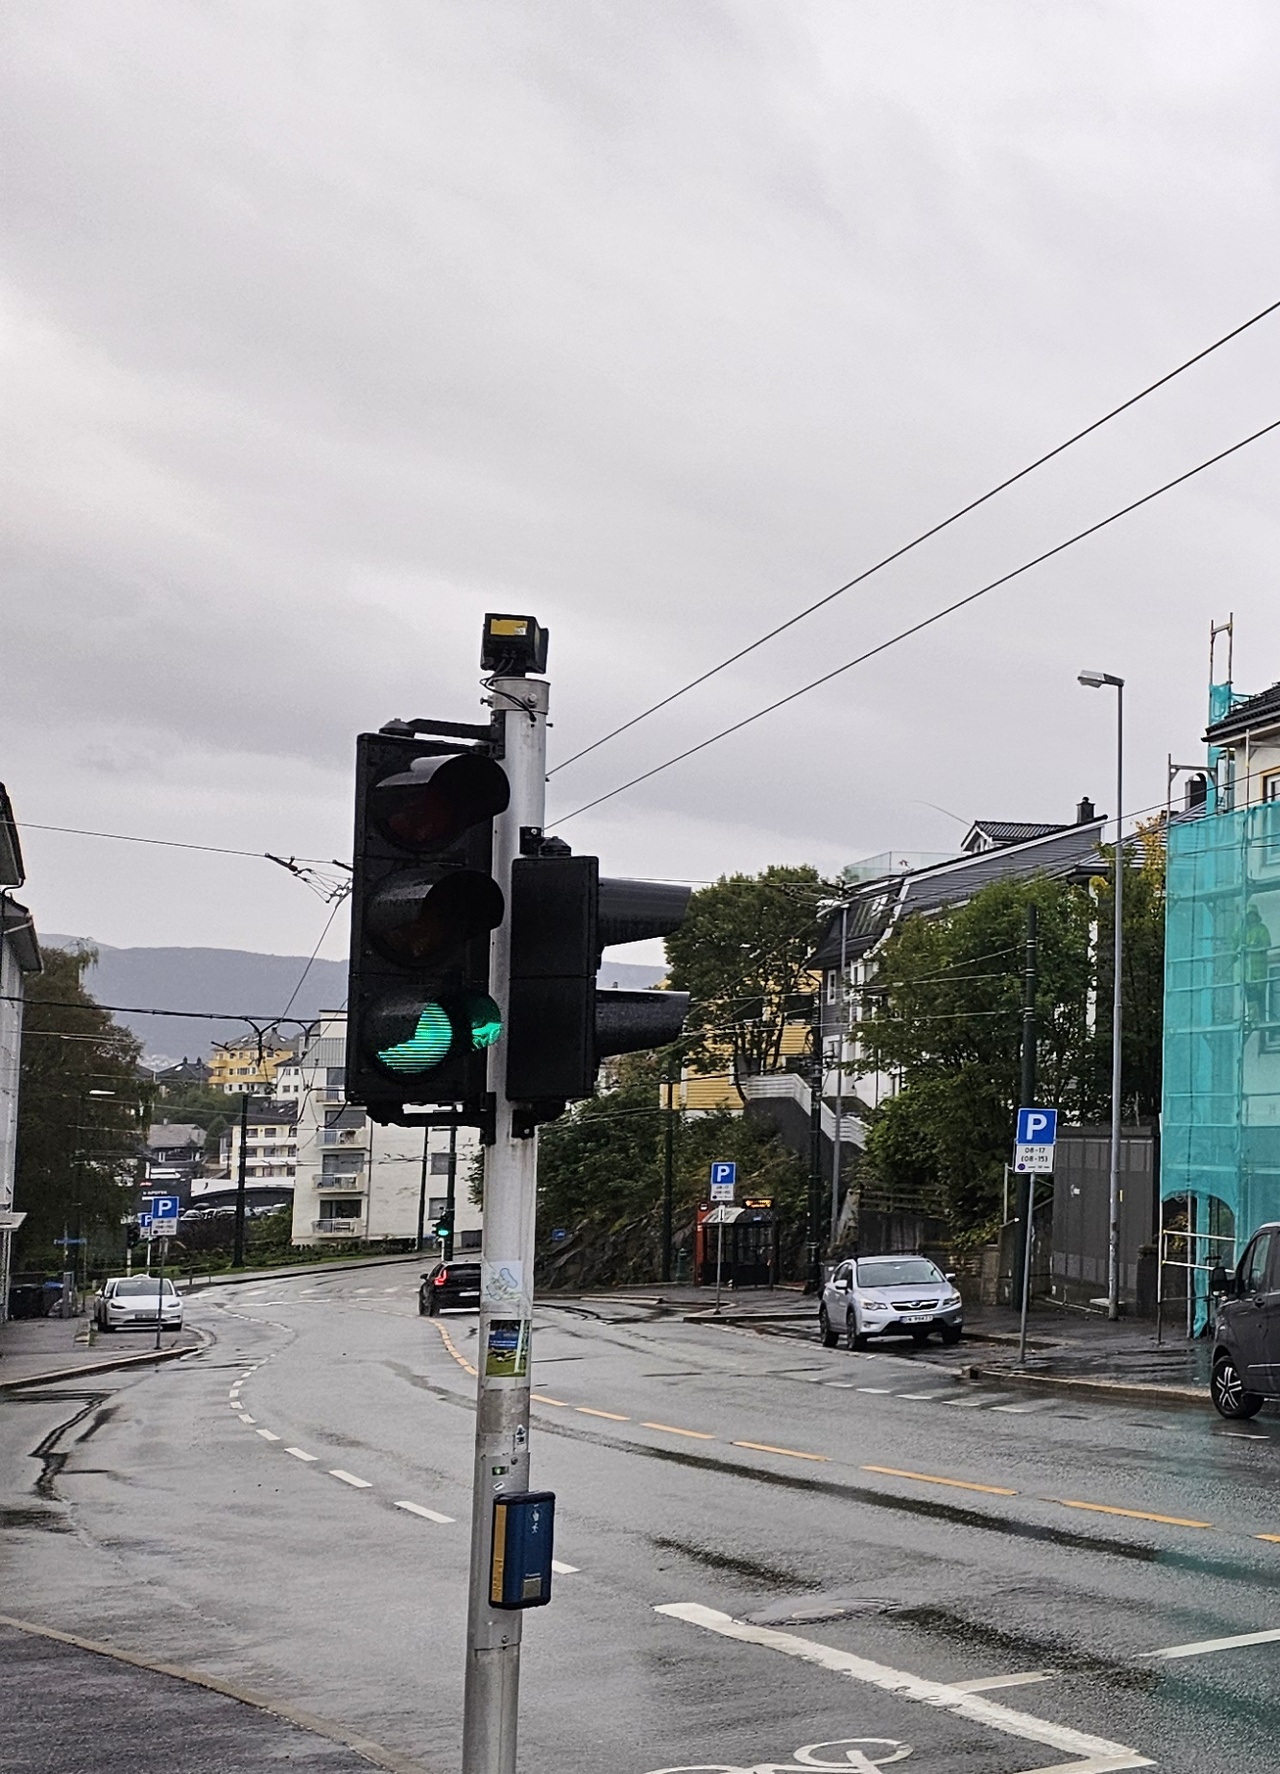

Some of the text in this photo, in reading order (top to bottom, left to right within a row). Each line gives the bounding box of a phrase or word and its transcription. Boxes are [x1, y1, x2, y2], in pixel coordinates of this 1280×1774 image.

[1026, 1113, 1048, 1141] P
[716, 1165, 731, 1182] P
[158, 1199, 172, 1216] P
